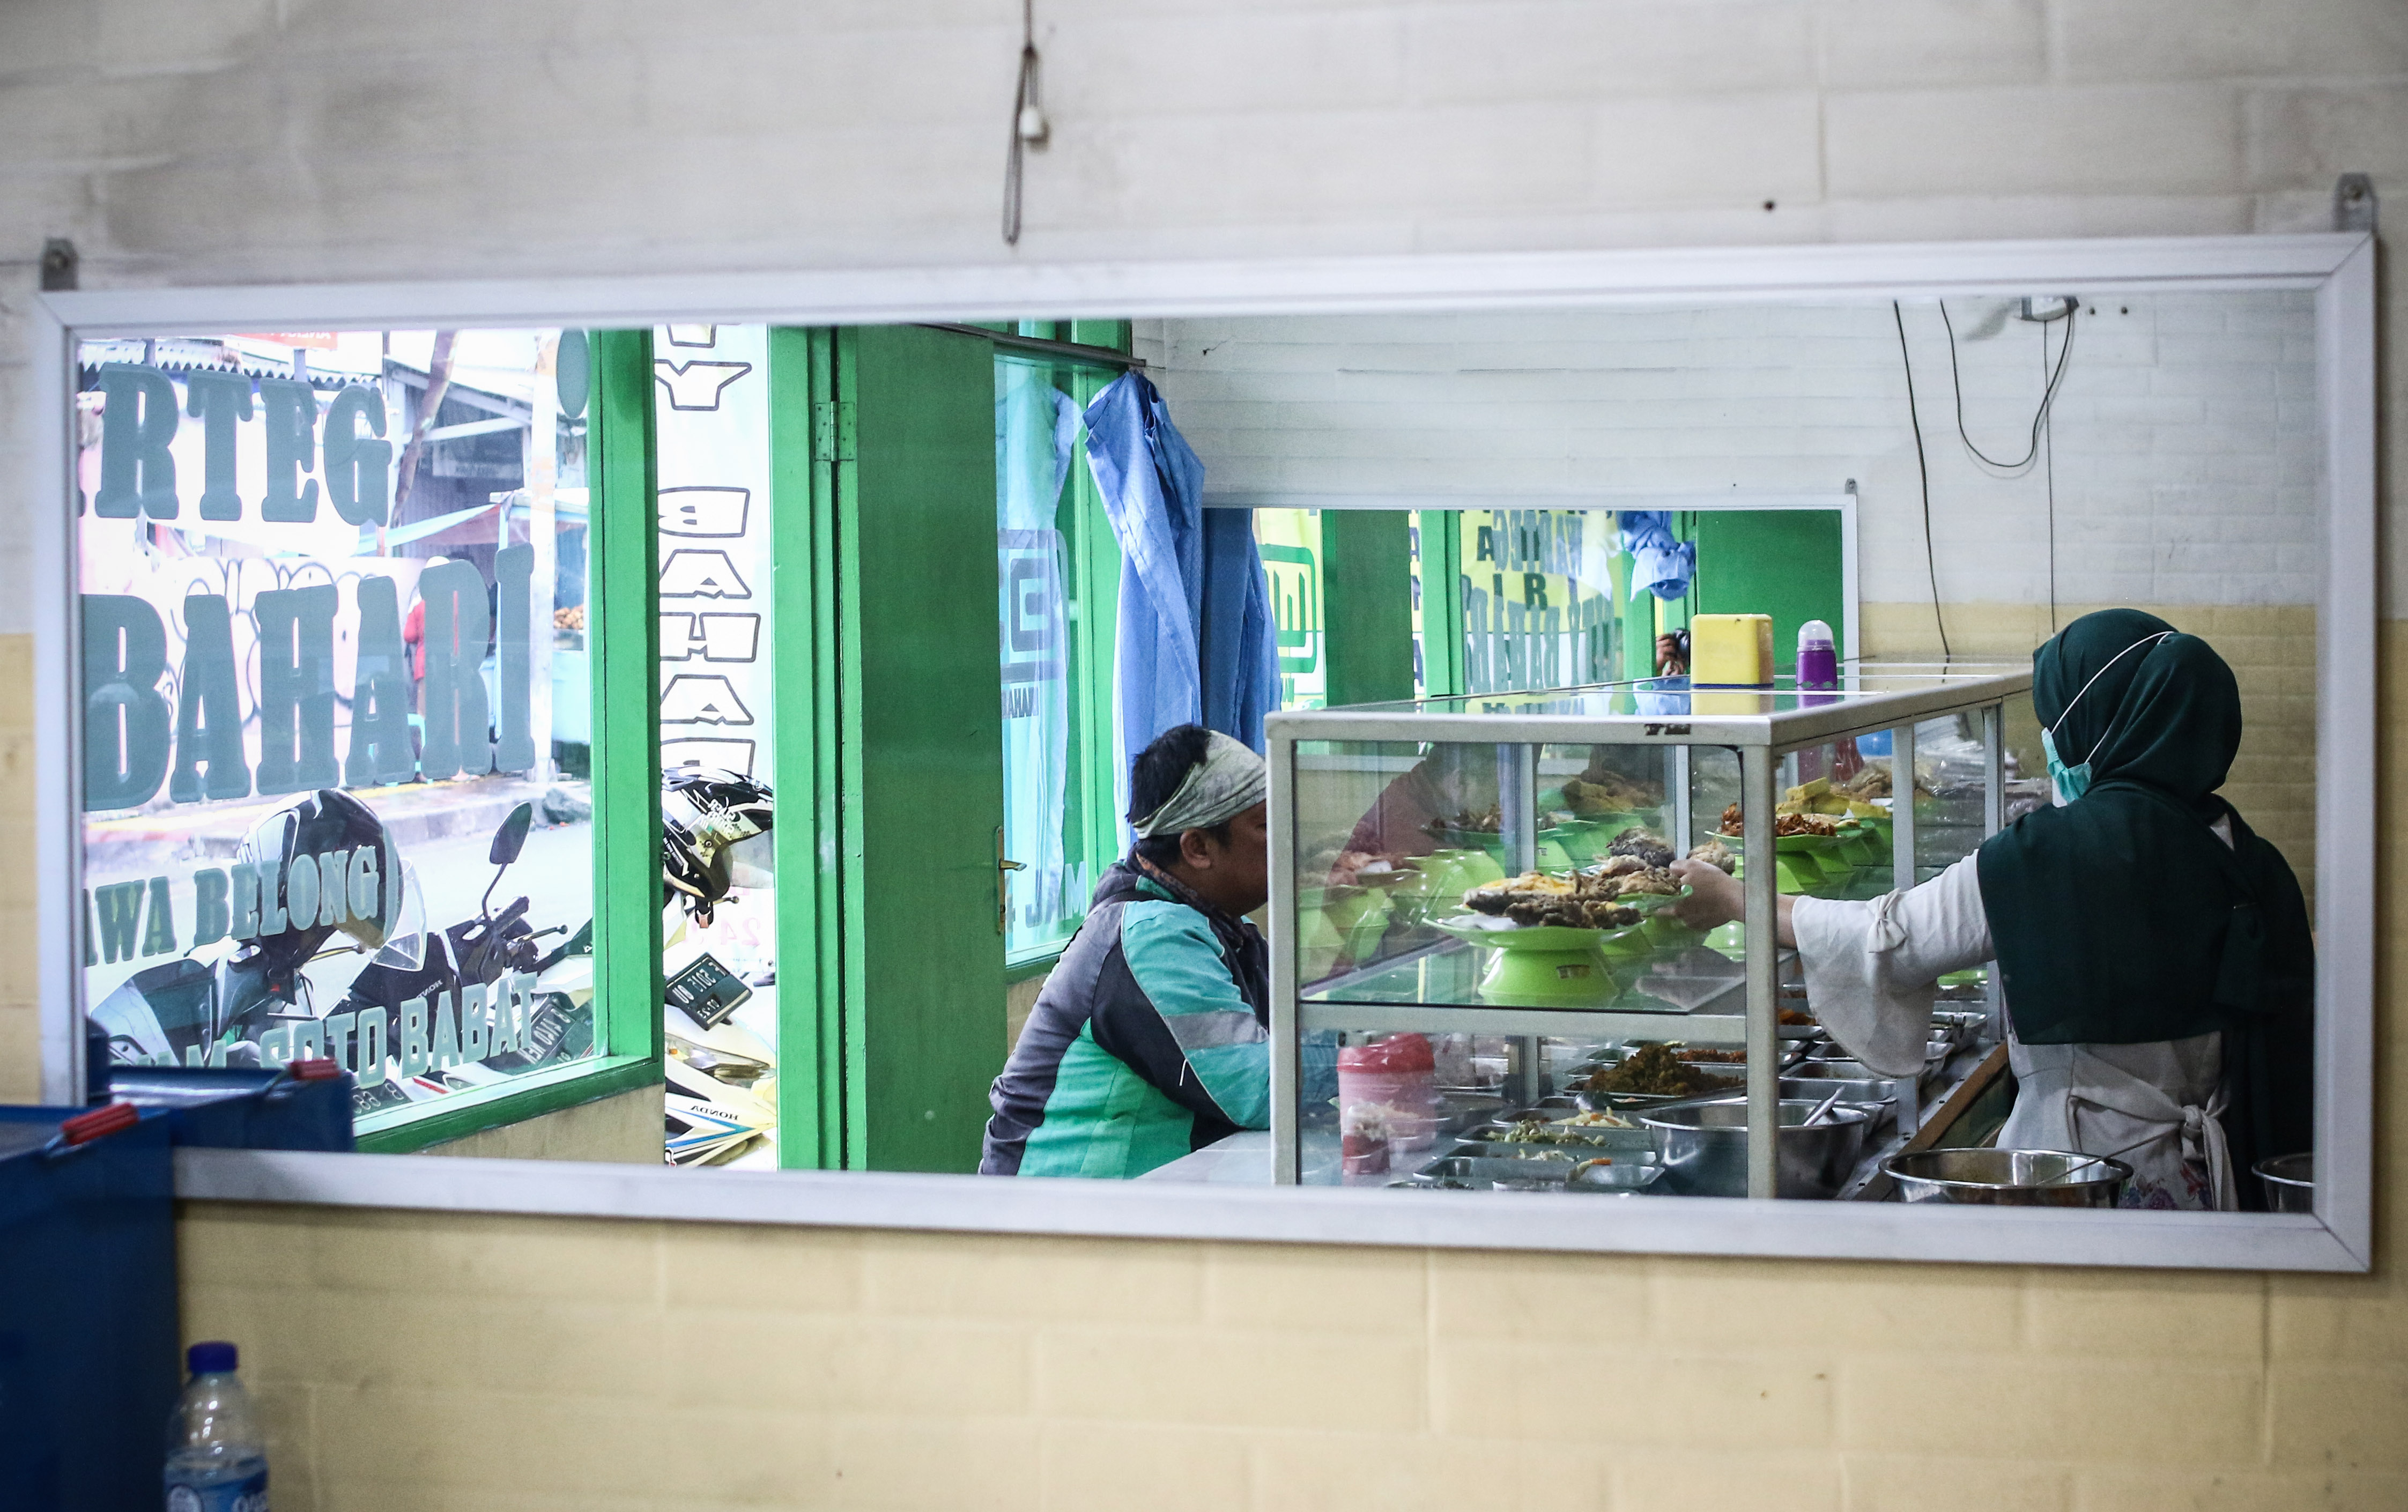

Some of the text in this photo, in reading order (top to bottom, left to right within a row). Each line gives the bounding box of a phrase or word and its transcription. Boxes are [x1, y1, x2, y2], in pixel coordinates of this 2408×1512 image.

[78, 362, 392, 527] RTEG
[81, 543, 535, 811] BAHARI
[194, 846, 380, 946] BELONG
[1025, 861, 1086, 928] JAM
[401, 972, 538, 1079] BABAT
